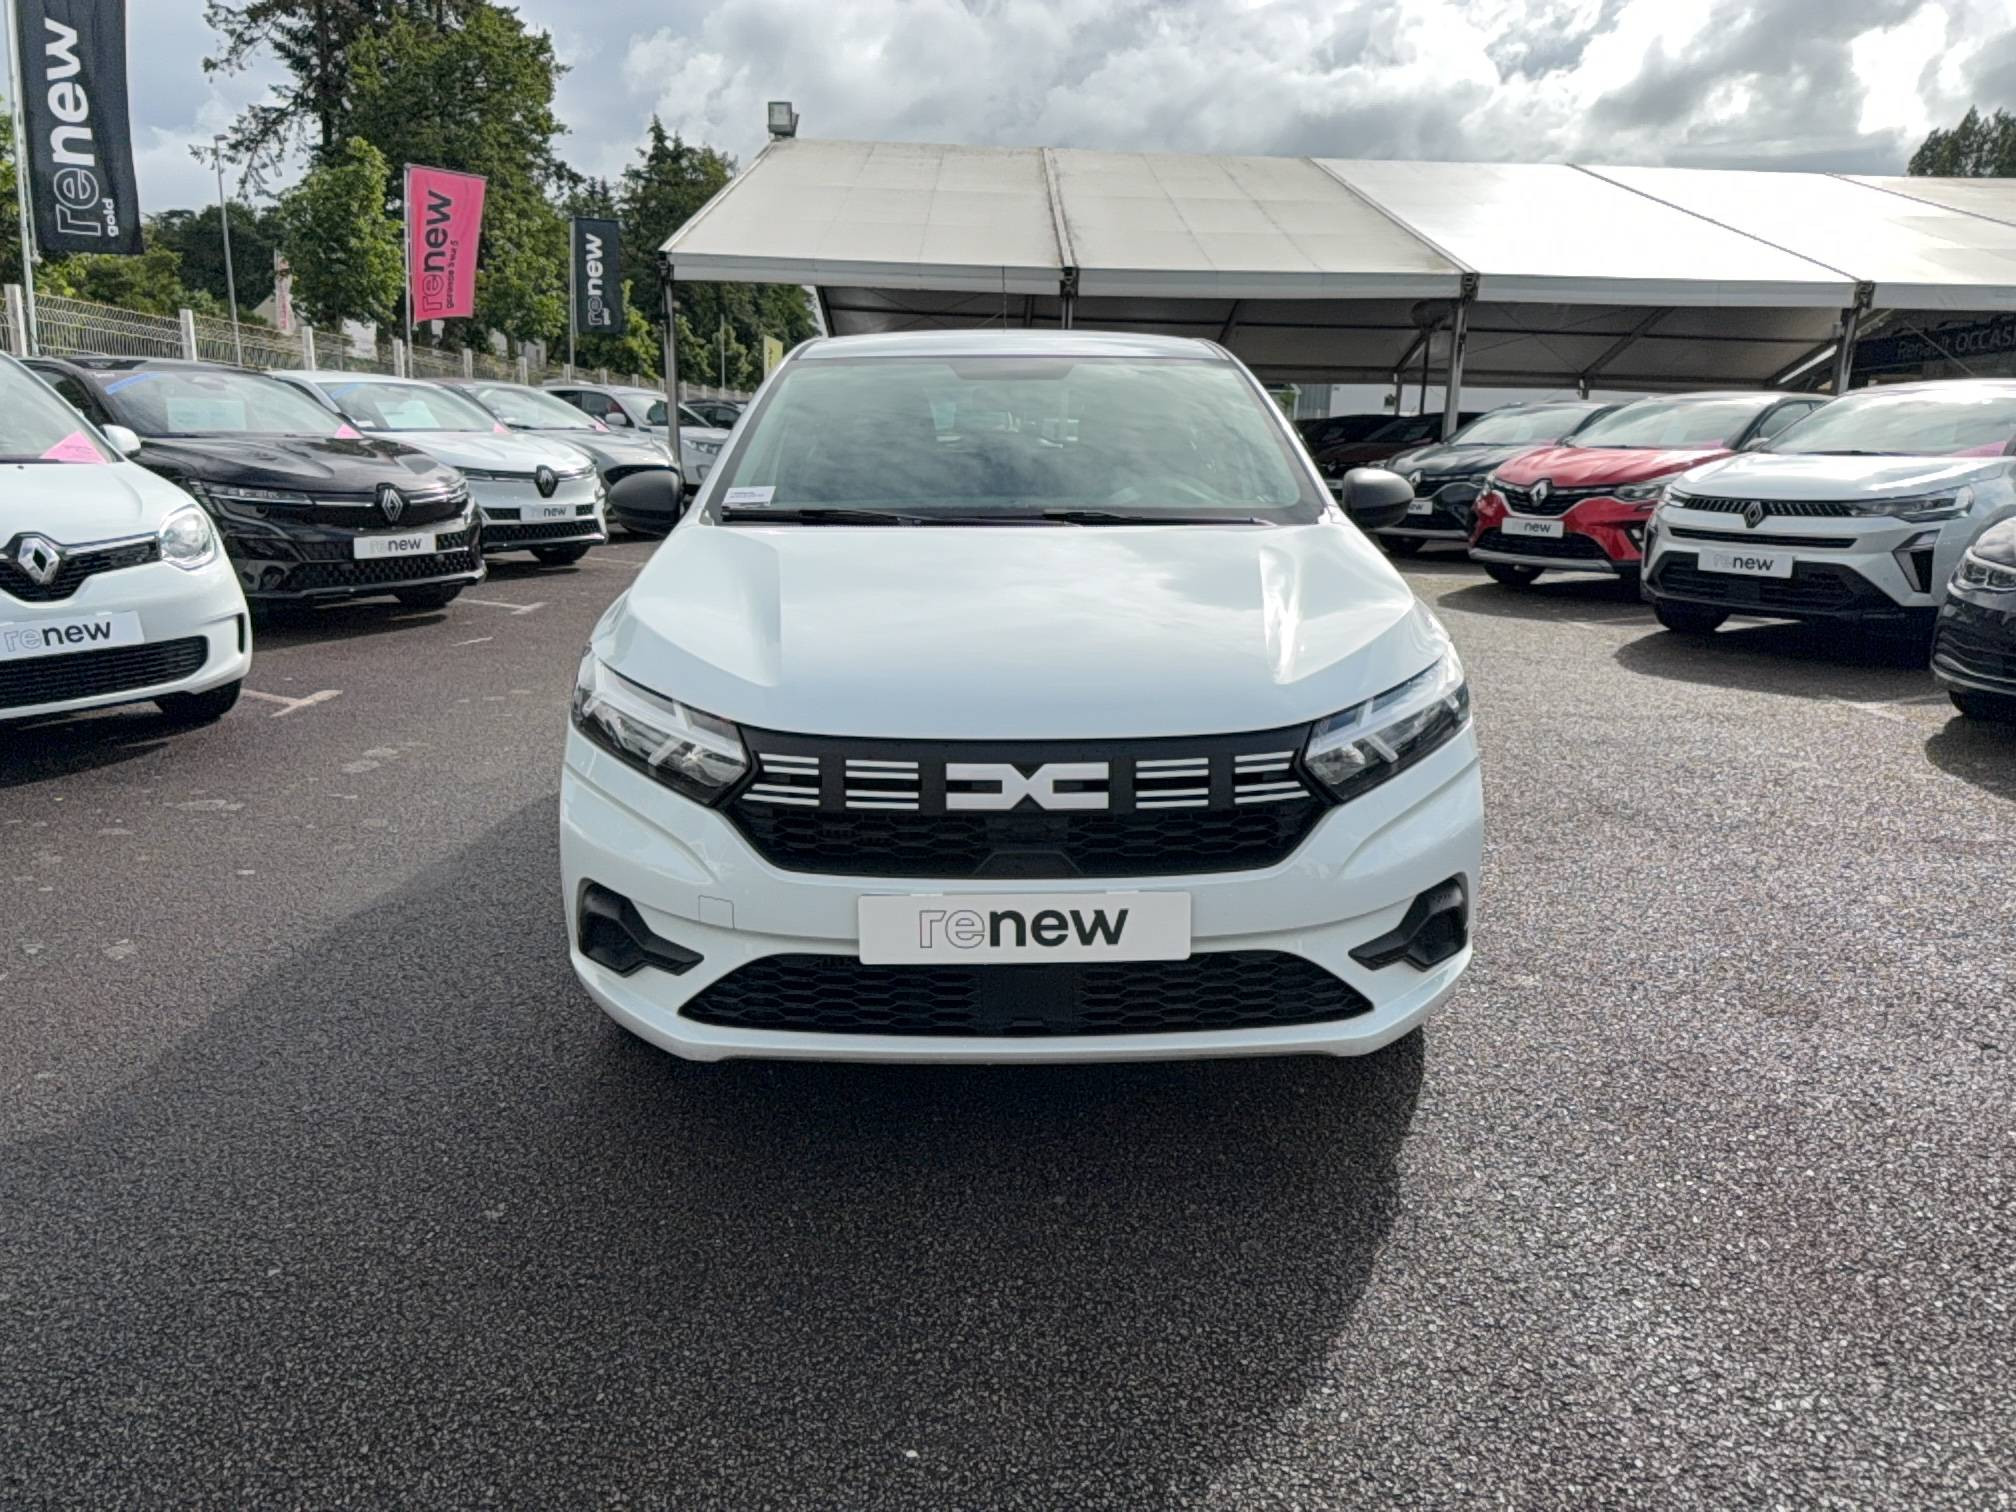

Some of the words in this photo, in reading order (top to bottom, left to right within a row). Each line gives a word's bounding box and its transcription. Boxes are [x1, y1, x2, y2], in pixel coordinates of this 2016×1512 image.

[44, 17, 101, 236] renew
[102, 198, 119, 238] gold
[422, 190, 452, 312] renew
[585, 233, 604, 326] renew
[4, 621, 111, 652] renew
[919, 908, 1129, 949] renew
